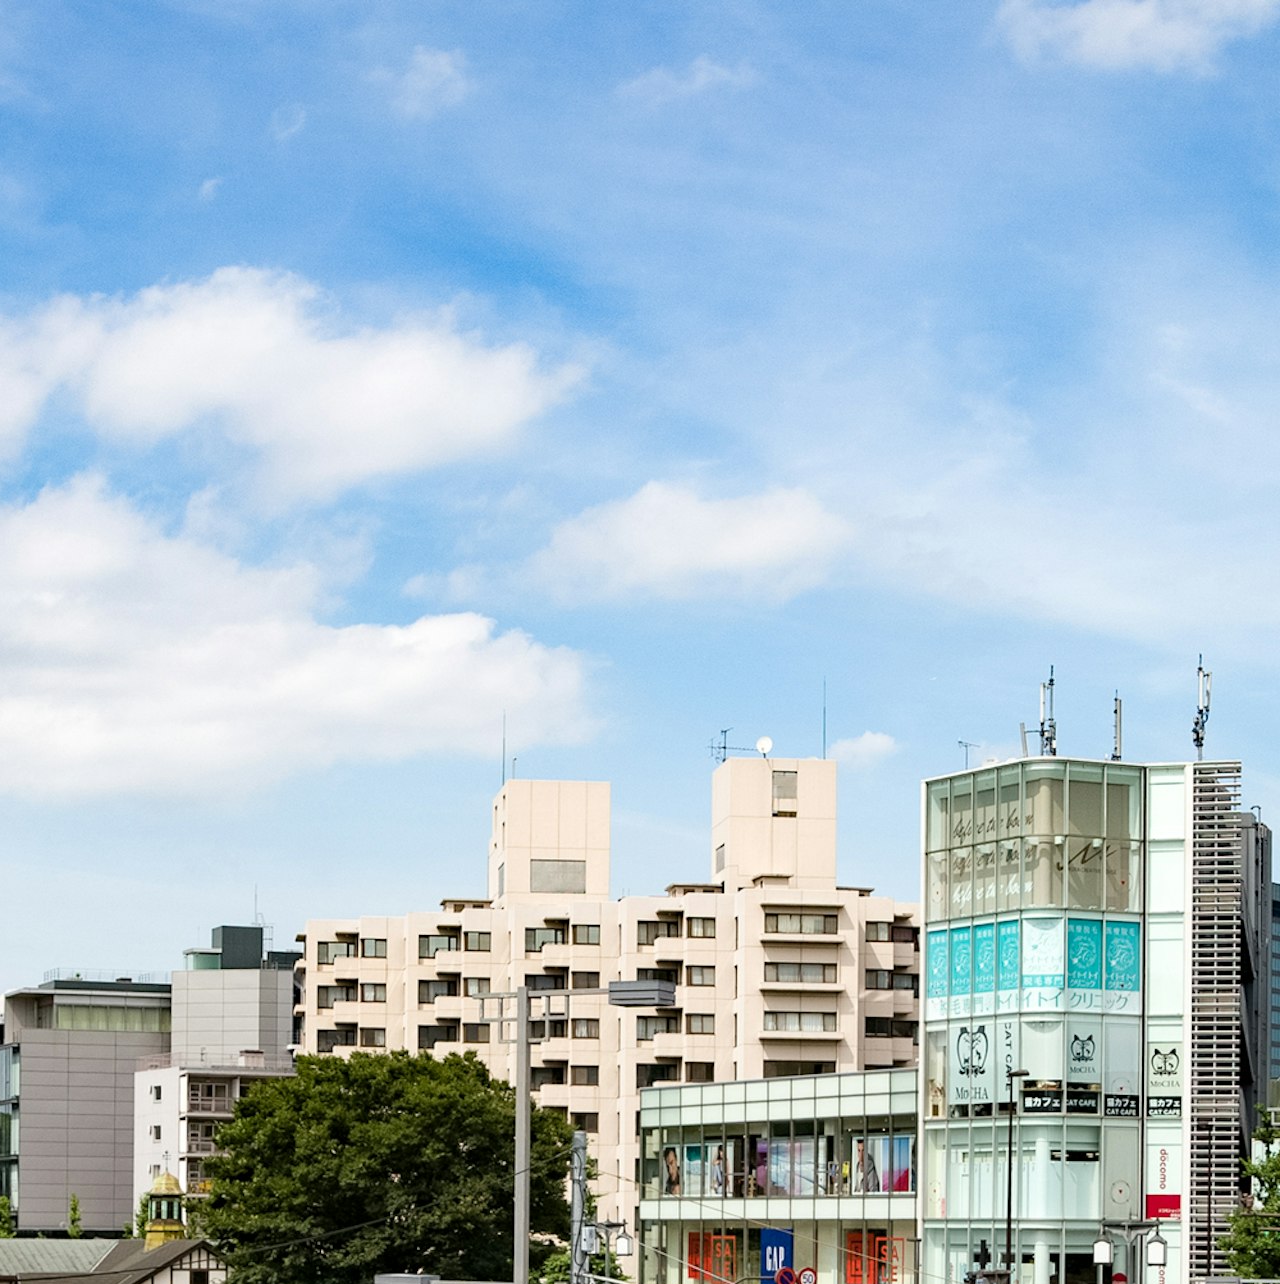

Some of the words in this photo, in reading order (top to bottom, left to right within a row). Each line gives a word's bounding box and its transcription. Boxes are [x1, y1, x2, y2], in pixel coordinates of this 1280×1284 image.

[1004, 1022, 1012, 1049] CAT
[1005, 1054, 1013, 1091] CAE
[955, 1086, 988, 1100] MoHA
[1159, 1149, 1168, 1190] docomo
[765, 1245, 785, 1271] GAP
[802, 1273, 814, 1284] 50
